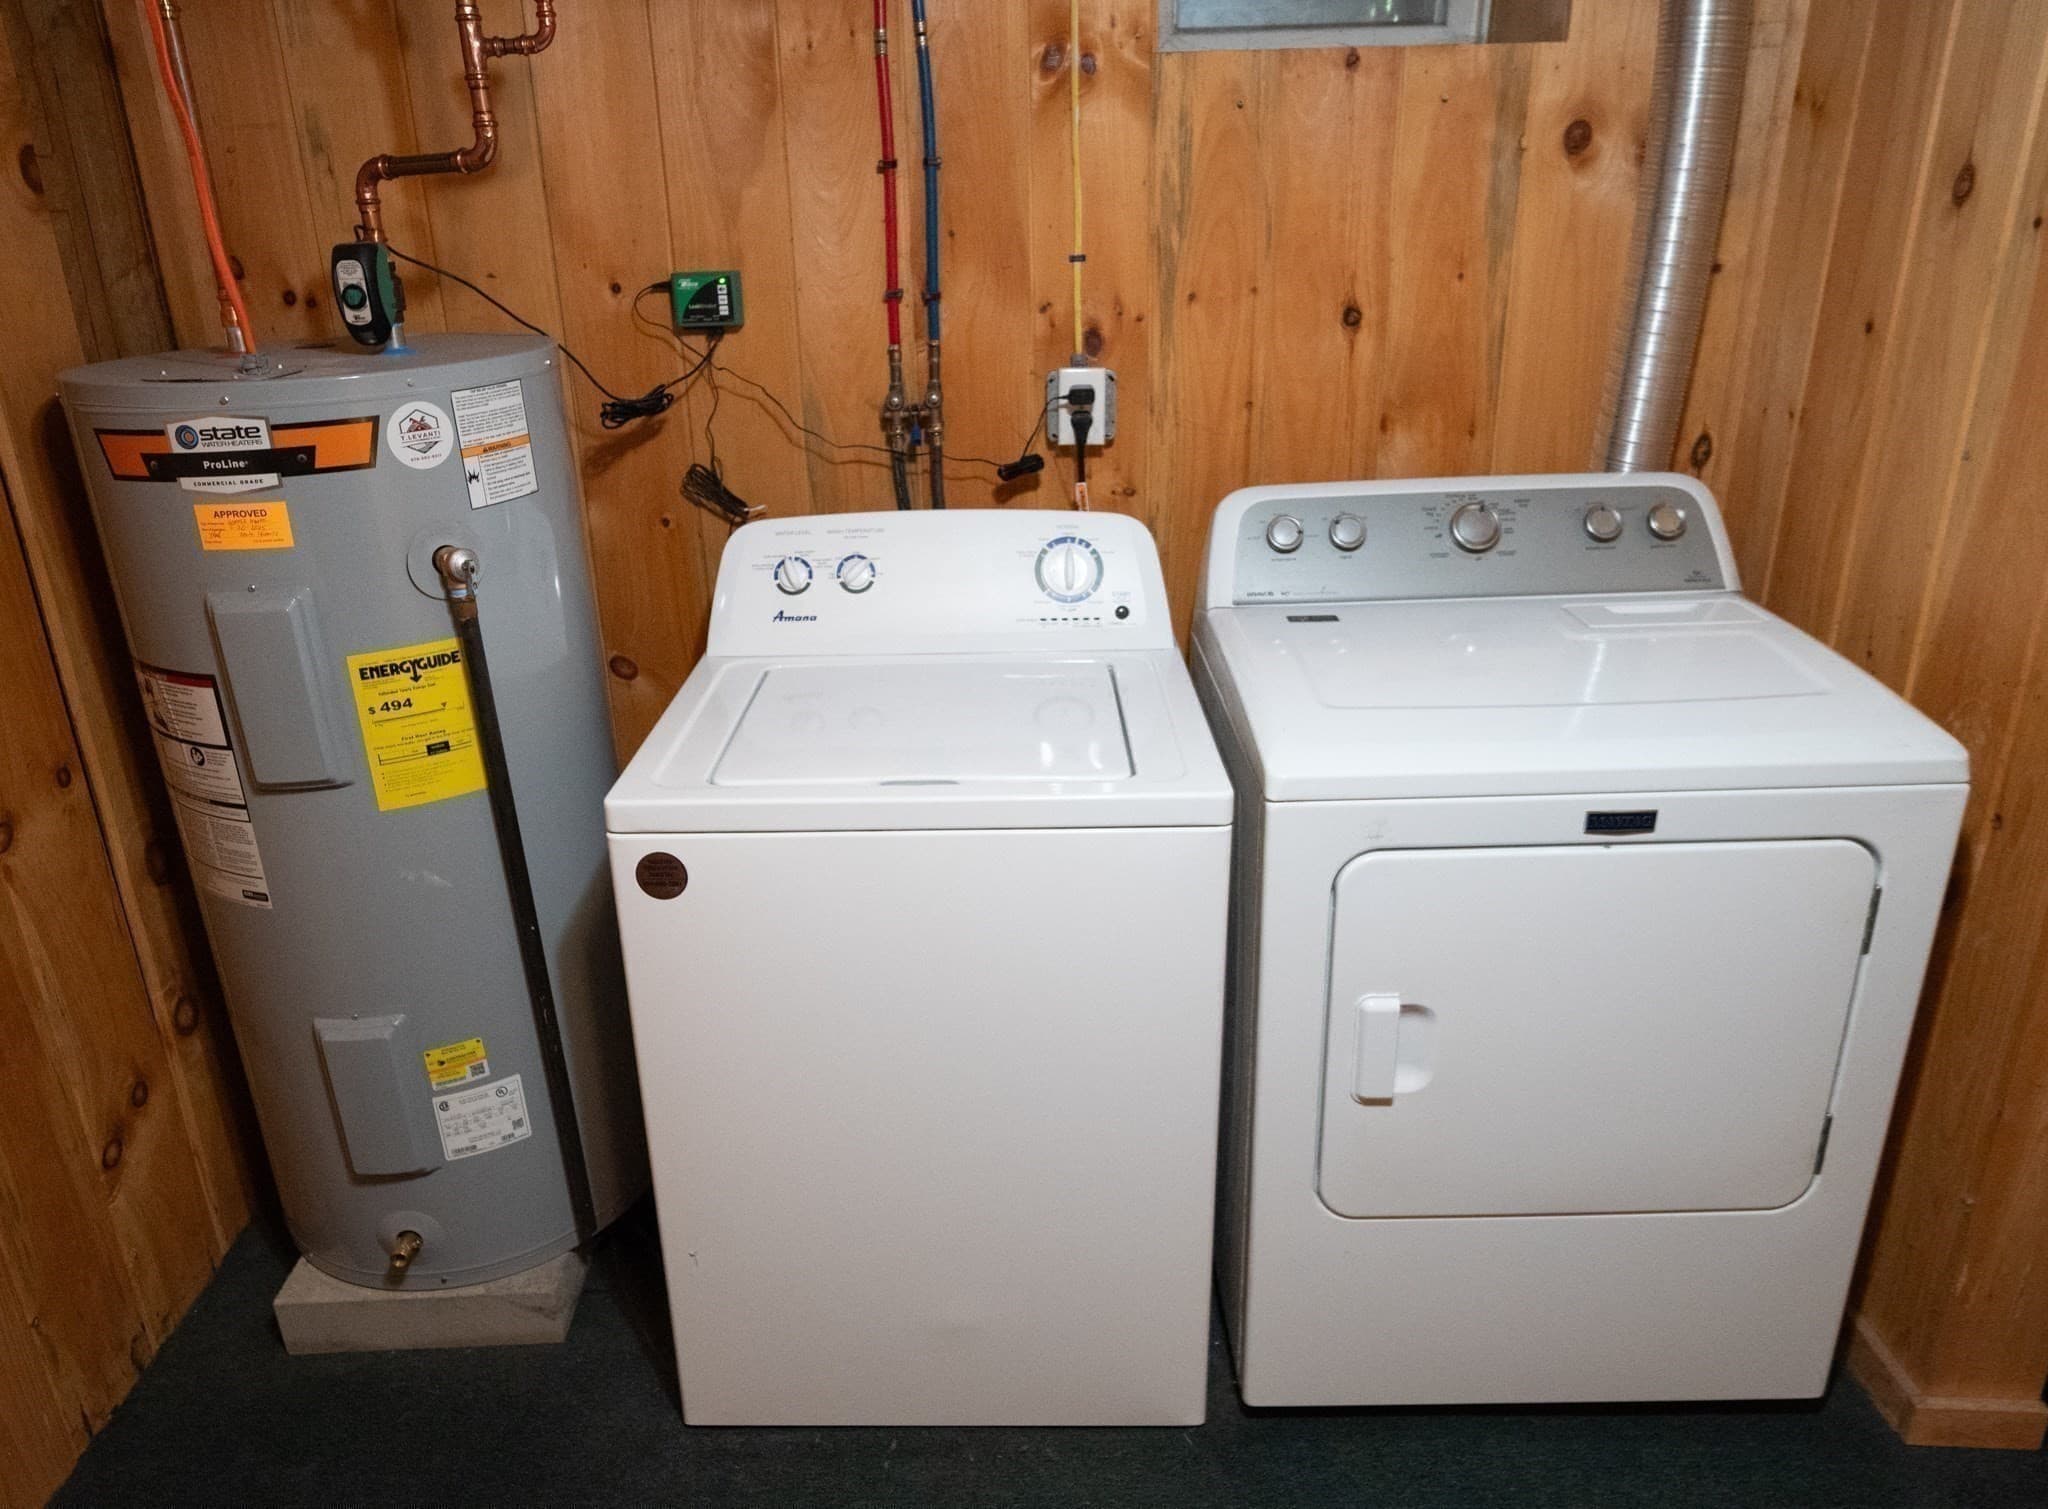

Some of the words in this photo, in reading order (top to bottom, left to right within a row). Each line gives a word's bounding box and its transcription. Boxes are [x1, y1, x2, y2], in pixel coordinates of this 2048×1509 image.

[200, 425, 262, 442] state
[203, 459, 246, 470] ProLine
[194, 480, 238, 488] COMMERCIAL
[213, 508, 268, 519] APPROVED
[773, 610, 818, 623] Amana
[359, 650, 462, 682] ENERGYGUIDE
[380, 697, 413, 713] 494
